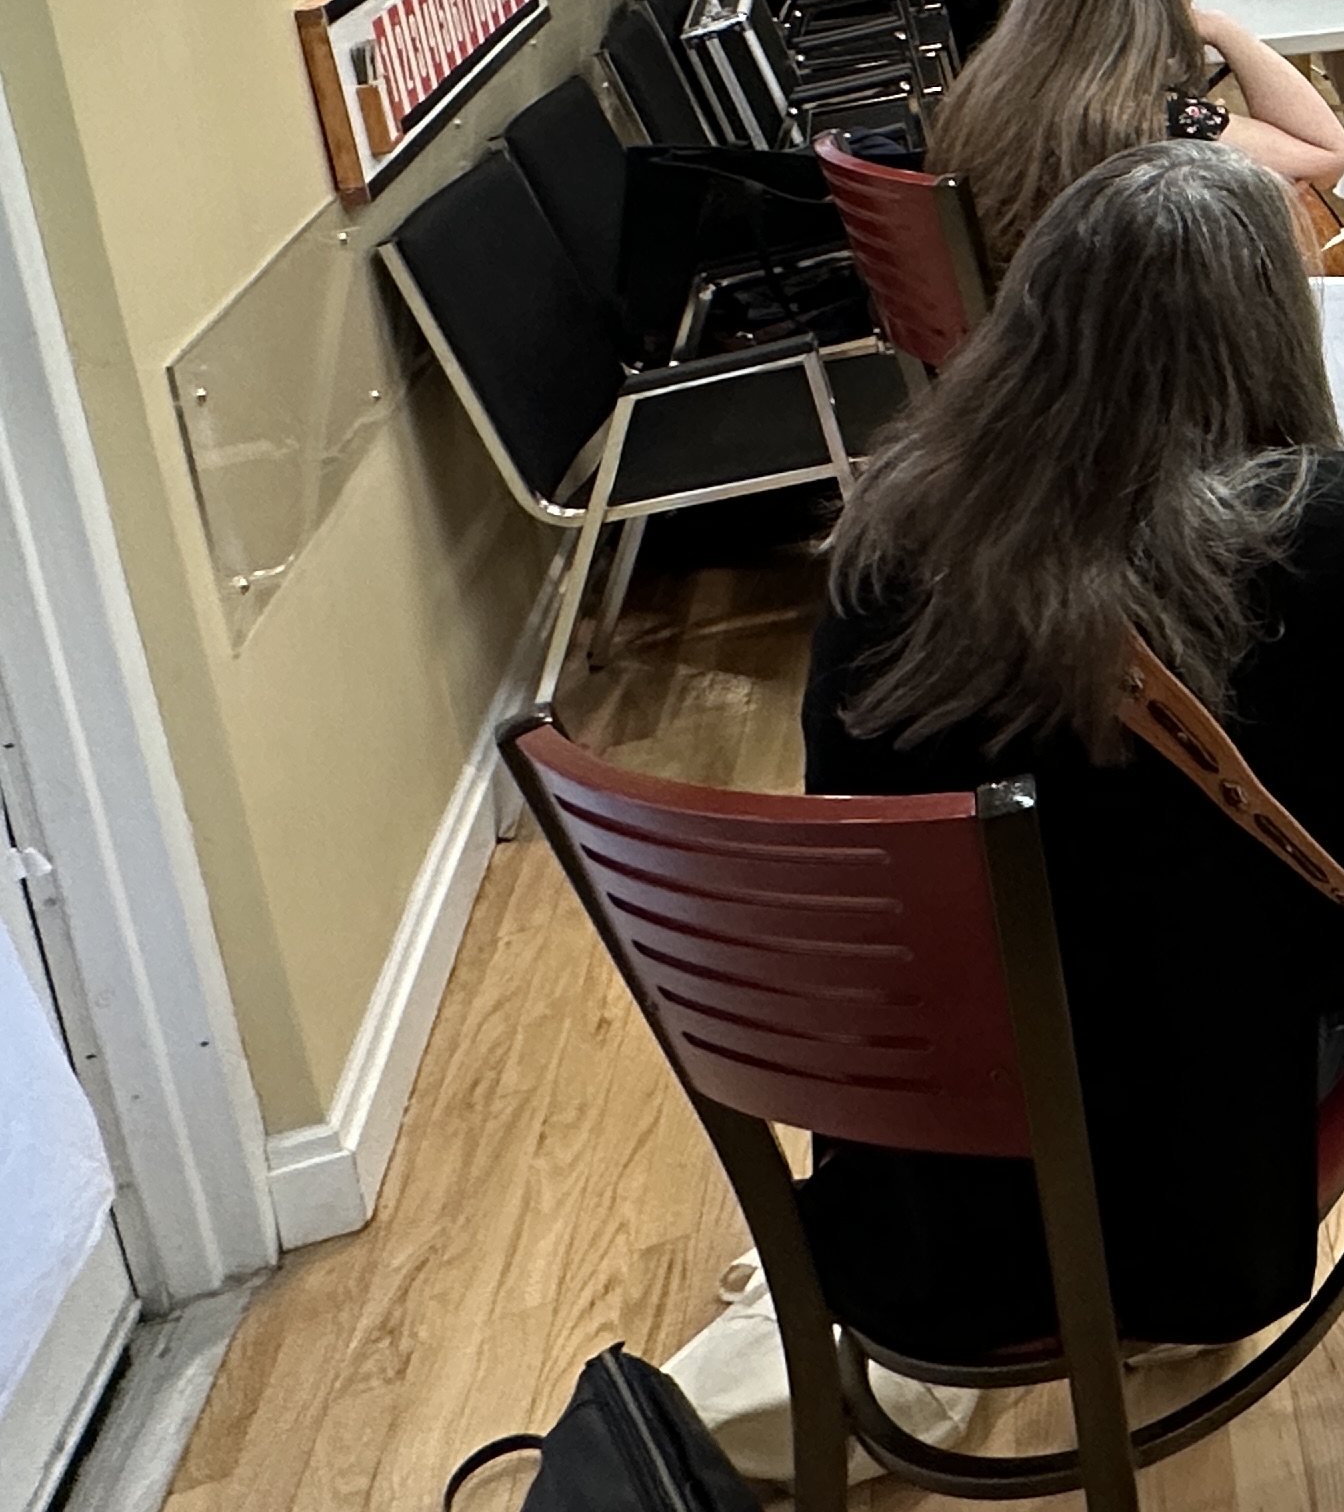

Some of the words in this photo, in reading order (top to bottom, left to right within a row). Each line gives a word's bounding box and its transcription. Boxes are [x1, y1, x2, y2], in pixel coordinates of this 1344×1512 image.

[380, 37, 398, 101] 1
[395, 25, 414, 90] 2
[409, 14, 427, 77] 3
[422, 2, 441, 64] 4
